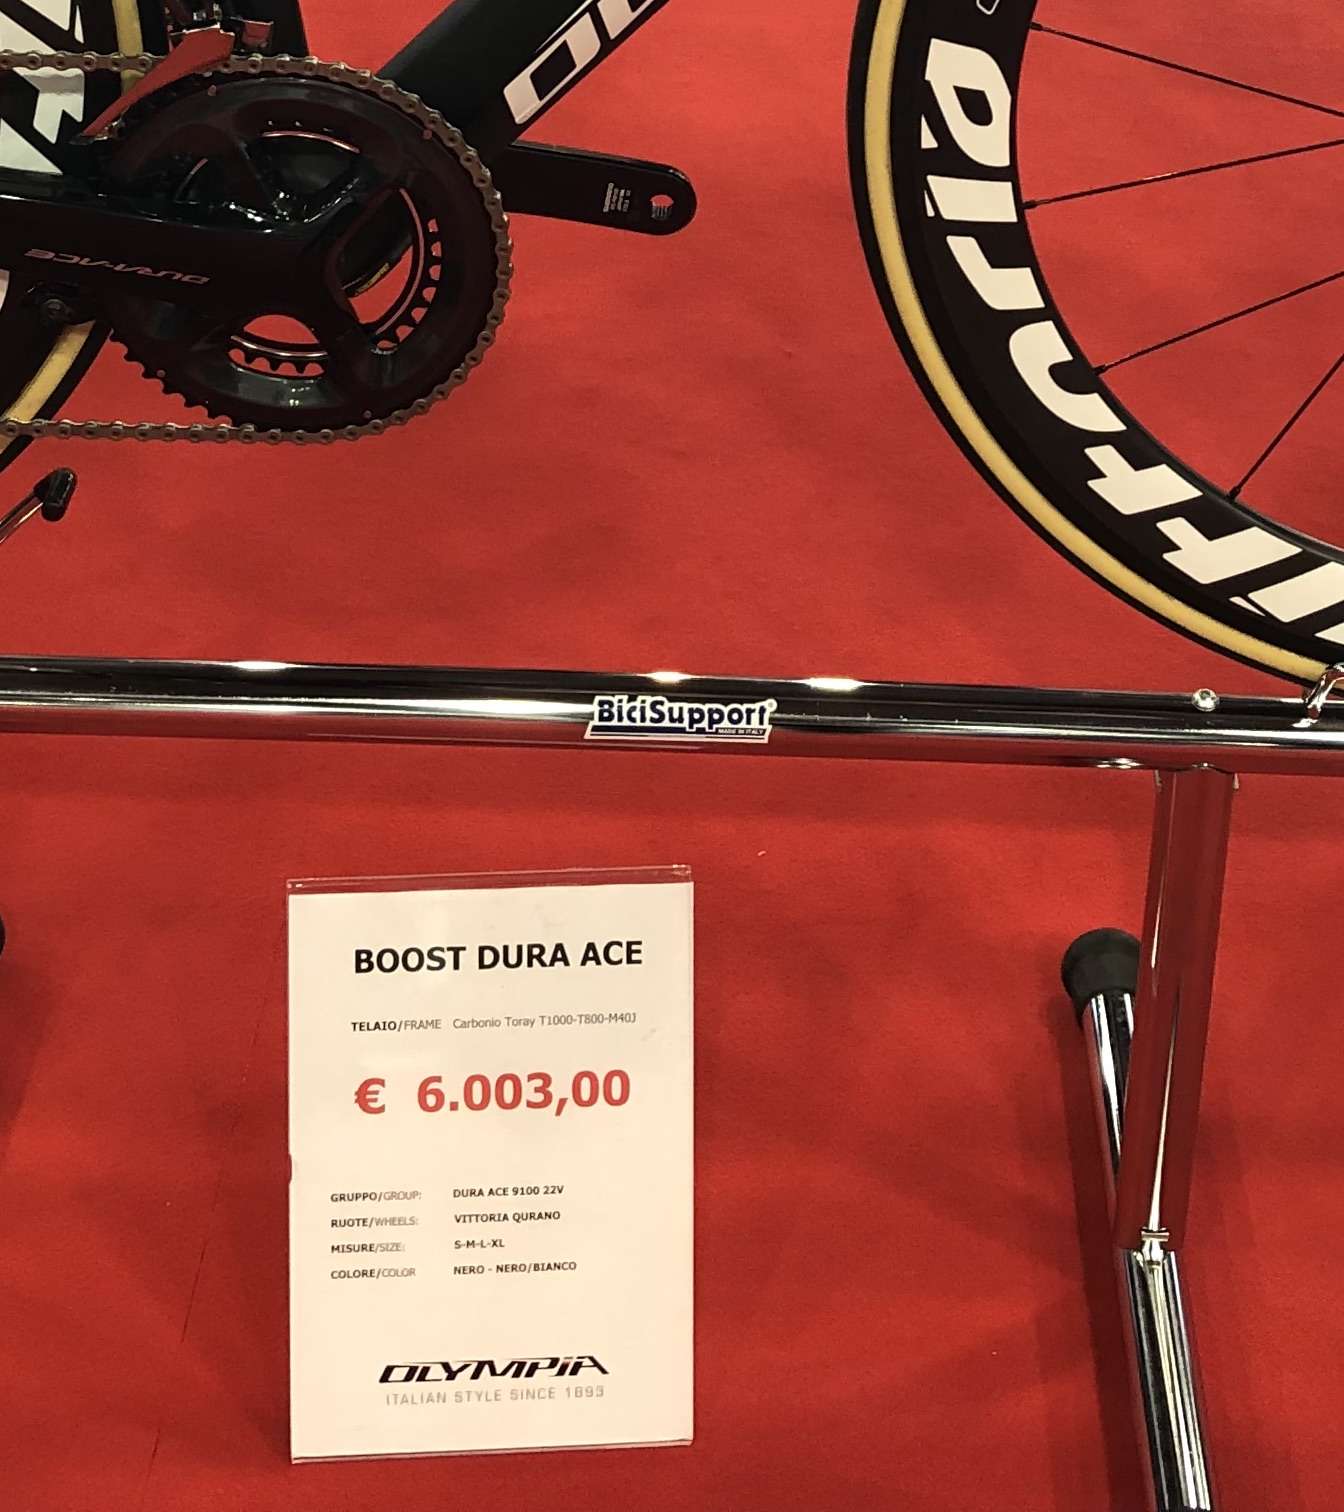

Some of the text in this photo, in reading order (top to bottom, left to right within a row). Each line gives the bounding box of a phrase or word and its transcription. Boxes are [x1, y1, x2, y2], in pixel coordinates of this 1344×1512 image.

[597, 698, 768, 732] BiciSupport
[354, 940, 643, 974] BOOST DURA ACE
[351, 1019, 442, 1033] TELAIO/FRAME
[452, 1017, 502, 1030] Carbonio
[504, 1015, 536, 1029] Toray
[354, 1069, 631, 1117] € 6.003,00
[330, 1185, 565, 1203] GRUPPO/GROUP: DURA ACE 9100 22V
[330, 1210, 561, 1229] RUOTE/WHEELS: VITTORIA QURANO
[330, 1239, 506, 1254] MISURE/SIZE: S-M-L-XL
[330, 1268, 417, 1280] COLORE/COLOR
[453, 1265, 486, 1276] NERO
[496, 1261, 578, 1274] NERO/BIANCO
[386, 1385, 605, 1406] ITALIAN STYLE SINCE 1893
